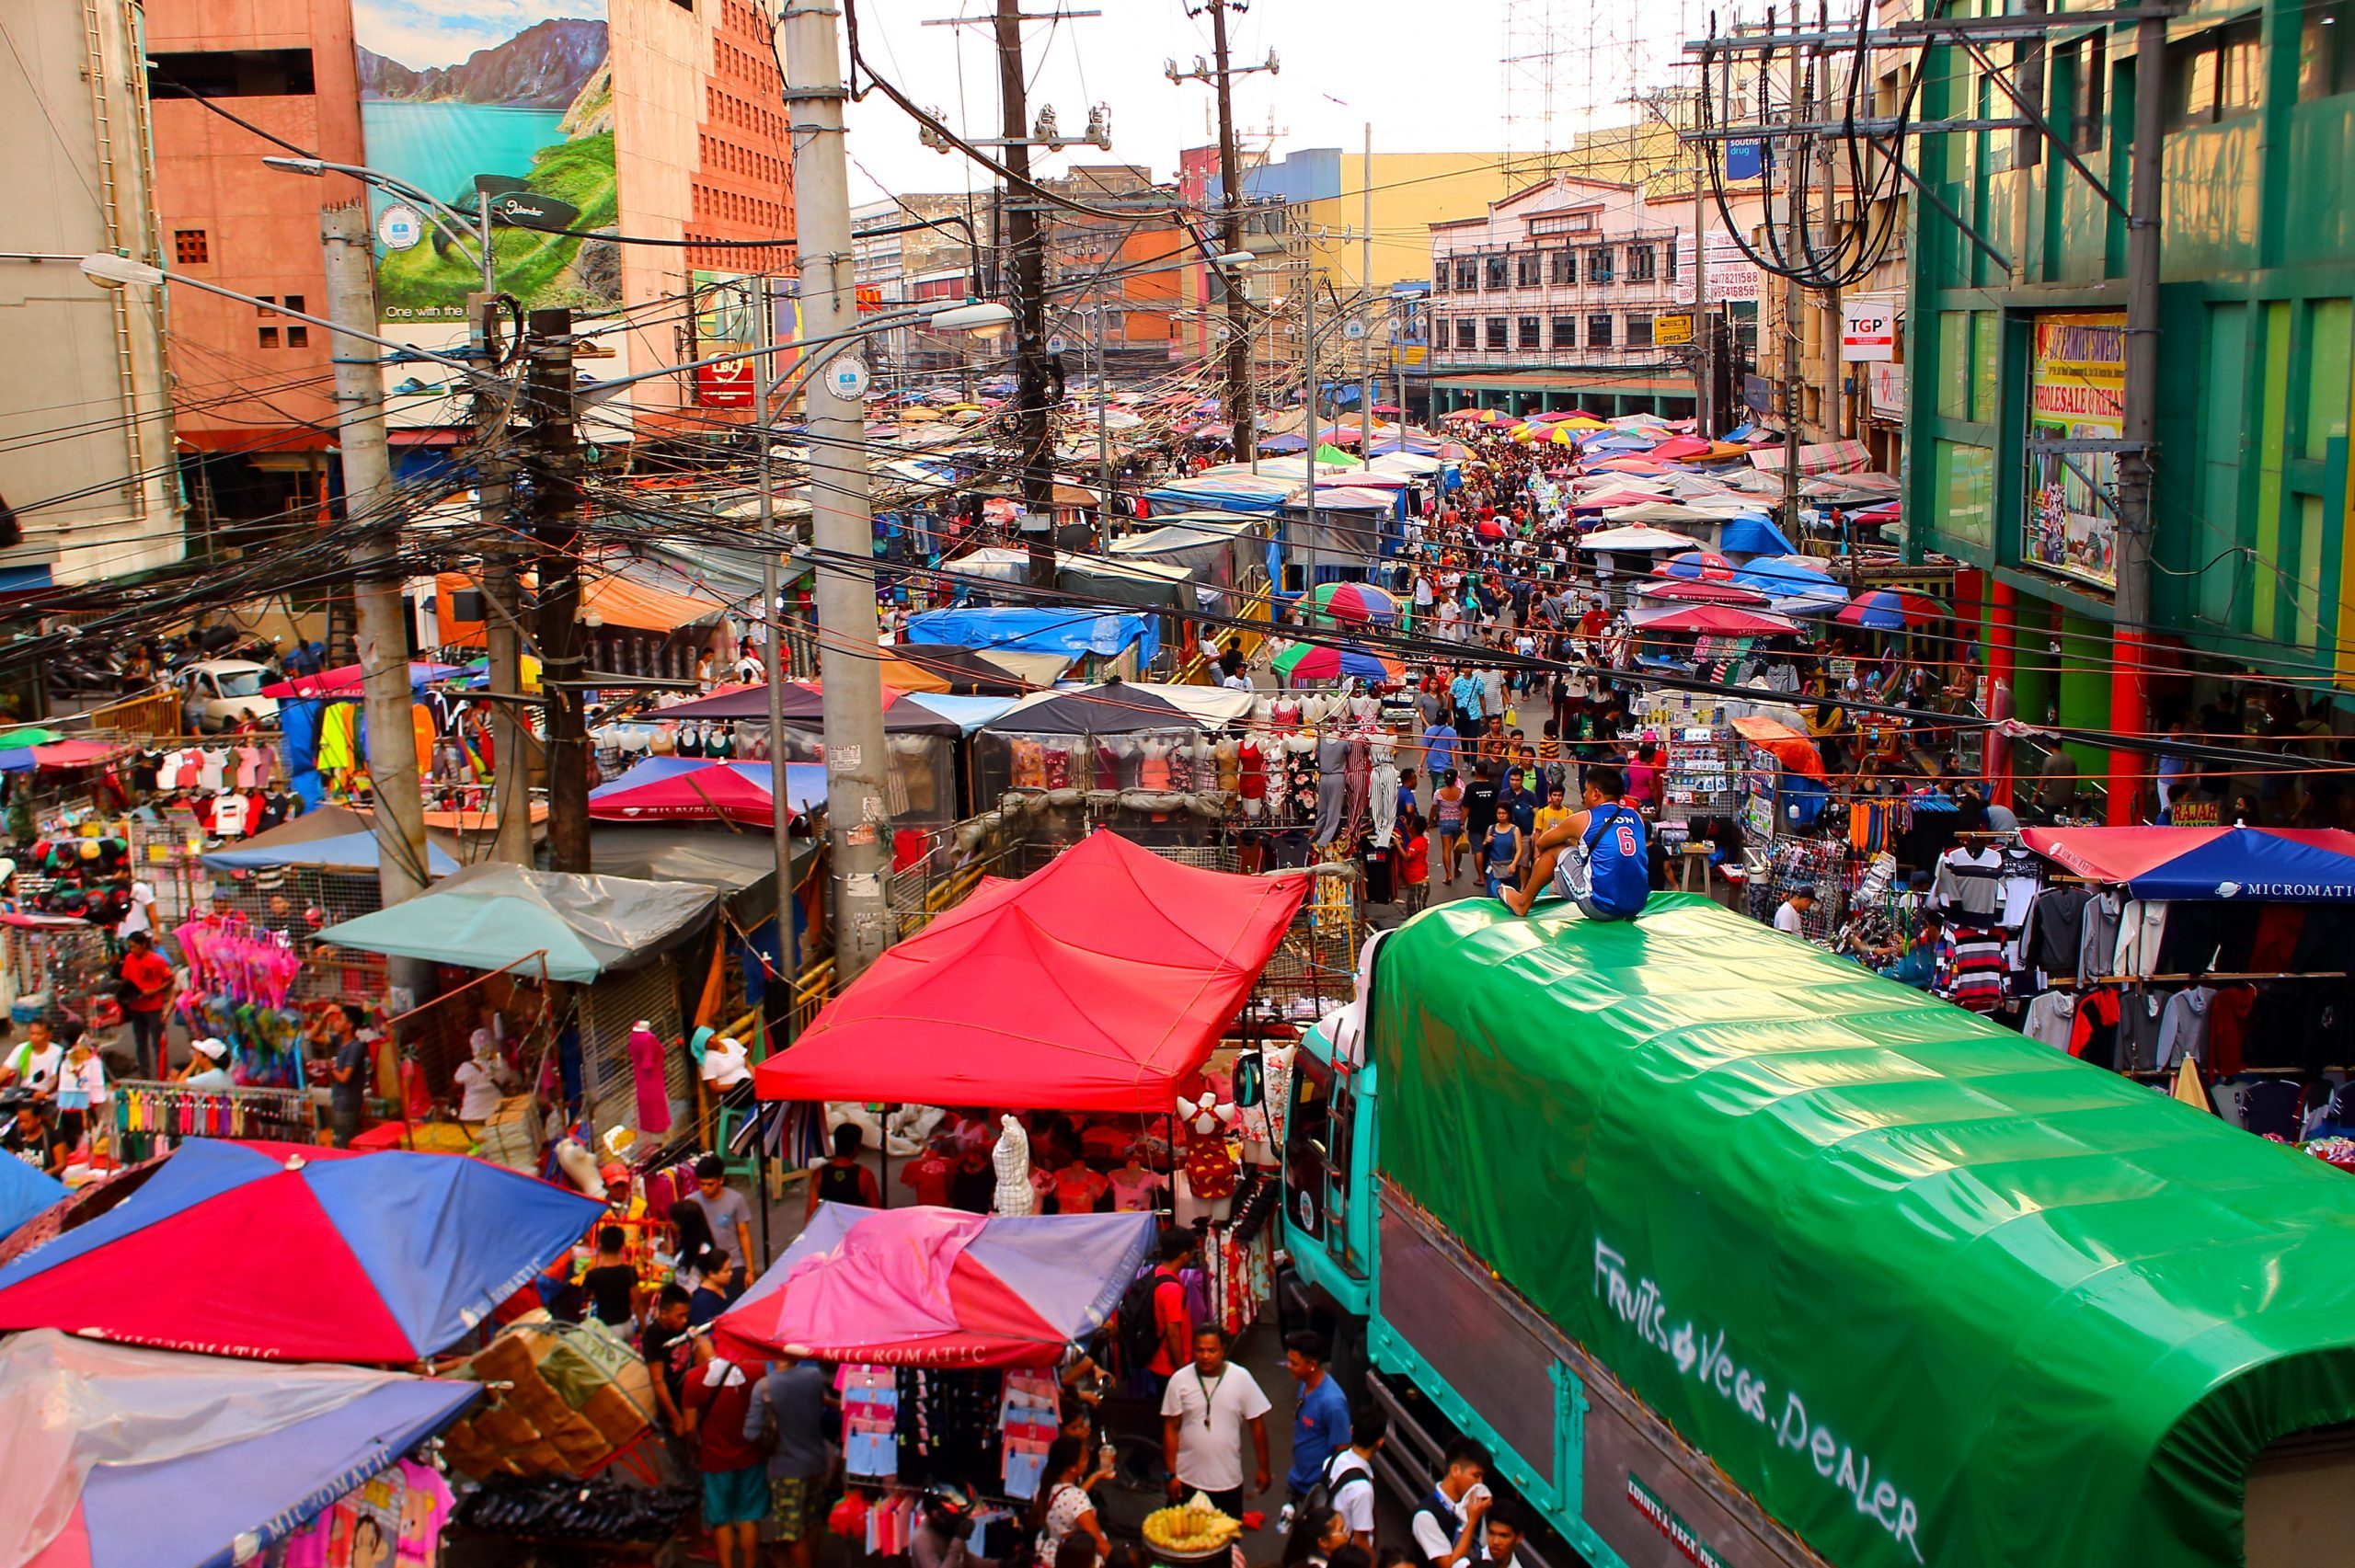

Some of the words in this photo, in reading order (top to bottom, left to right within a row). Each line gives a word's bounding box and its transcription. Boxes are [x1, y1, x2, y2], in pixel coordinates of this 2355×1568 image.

[1730, 147, 1750, 156] drug
[385, 306, 413, 319] One
[415, 304, 441, 318] with
[443, 304, 464, 317] the
[1849, 318, 1883, 333] TGP
[2034, 383, 2086, 414] WHOLESALE
[2174, 802, 2217, 821] RAJAH
[1616, 826, 1637, 857] 6
[2247, 883, 2355, 897] MICROMATI
[821, 1345, 987, 1363] MICROMATIC
[266, 1445, 391, 1543] MICROMATIC
